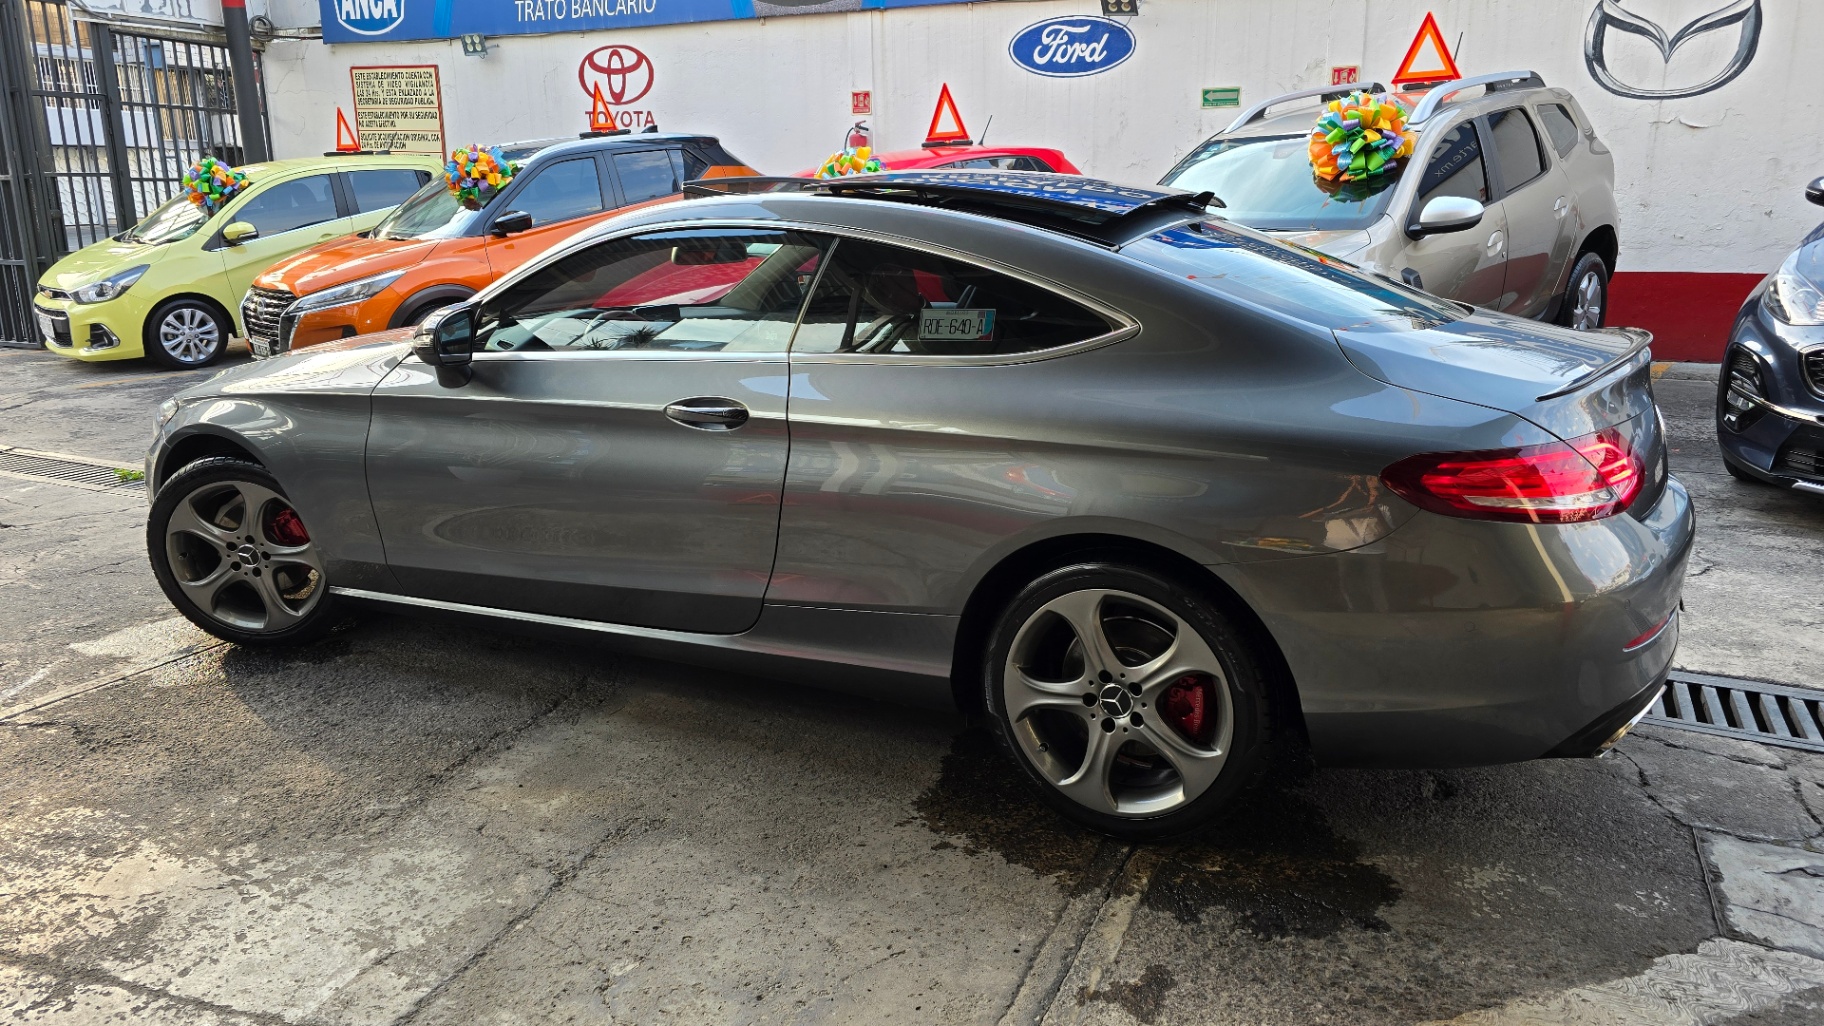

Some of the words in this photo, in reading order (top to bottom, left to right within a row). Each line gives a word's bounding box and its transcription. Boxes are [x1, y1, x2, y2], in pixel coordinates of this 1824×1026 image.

[514, 0, 566, 22] TRATO
[571, 0, 656, 18] BANCARIO
[1033, 25, 1109, 65] Ford
[355, 72, 366, 80] ESTE
[366, 71, 405, 80] ESTABLECIMIENTO
[405, 71, 423, 80] CUENTA
[423, 71, 433, 80] CON
[356, 80, 376, 88] SISTEMA
[377, 80, 385, 88] DE
[404, 80, 434, 88] VIGILANCIA
[357, 89, 365, 97] LAS
[398, 88, 423, 97] ENLAZADO
[923, 318, 984, 335] RDE-640-A
